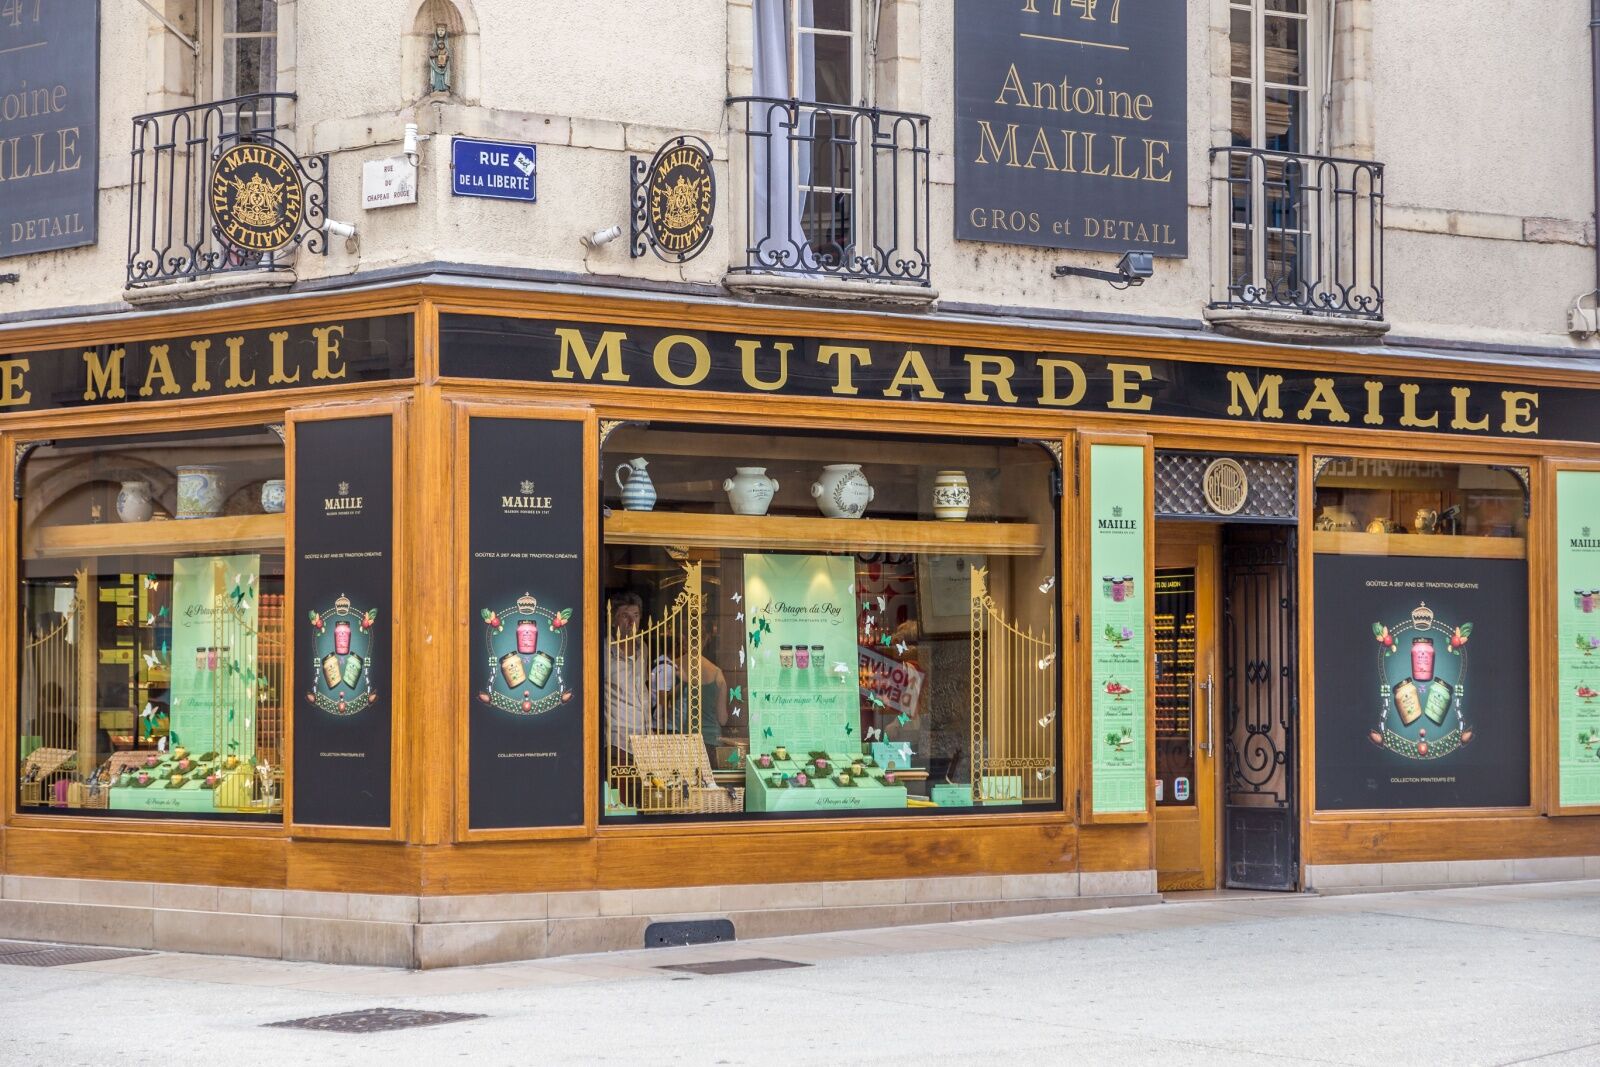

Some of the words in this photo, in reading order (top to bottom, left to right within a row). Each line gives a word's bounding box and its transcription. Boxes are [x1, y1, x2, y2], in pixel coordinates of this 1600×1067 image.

[0, 79, 68, 121] oine
[994, 62, 1153, 121] Antoine
[225, 148, 290, 177] MAILLE
[479, 151, 510, 168] RUE
[658, 150, 703, 179] MAILLE
[974, 120, 1173, 182] MAILLE
[383, 165, 394, 173] RUE
[459, 174, 471, 186] DE
[472, 175, 484, 187] LA
[213, 172, 229, 213] 1747
[285, 183, 301, 223] 1747
[393, 190, 410, 199] ROUGE
[651, 184, 662, 223] 1747
[700, 175, 712, 215] 1747
[11, 213, 84, 243] DETAIL
[225, 219, 290, 247] MAILLE
[659, 219, 704, 249] MAILLE
[969, 206, 1041, 233] GROS
[1052, 217, 1071, 236] et
[1084, 216, 1176, 246] DETAIL
[83, 325, 347, 401] MAILLE
[551, 327, 1153, 411] MOUTARDE
[1226, 370, 1540, 435] MAILLE
[324, 497, 363, 510] MAILLE
[502, 496, 552, 508] MAILLE
[1098, 519, 1137, 530] MAILLE
[774, 602, 808, 616] Potager
[809, 604, 819, 613] du
[820, 602, 842, 616] Roy
